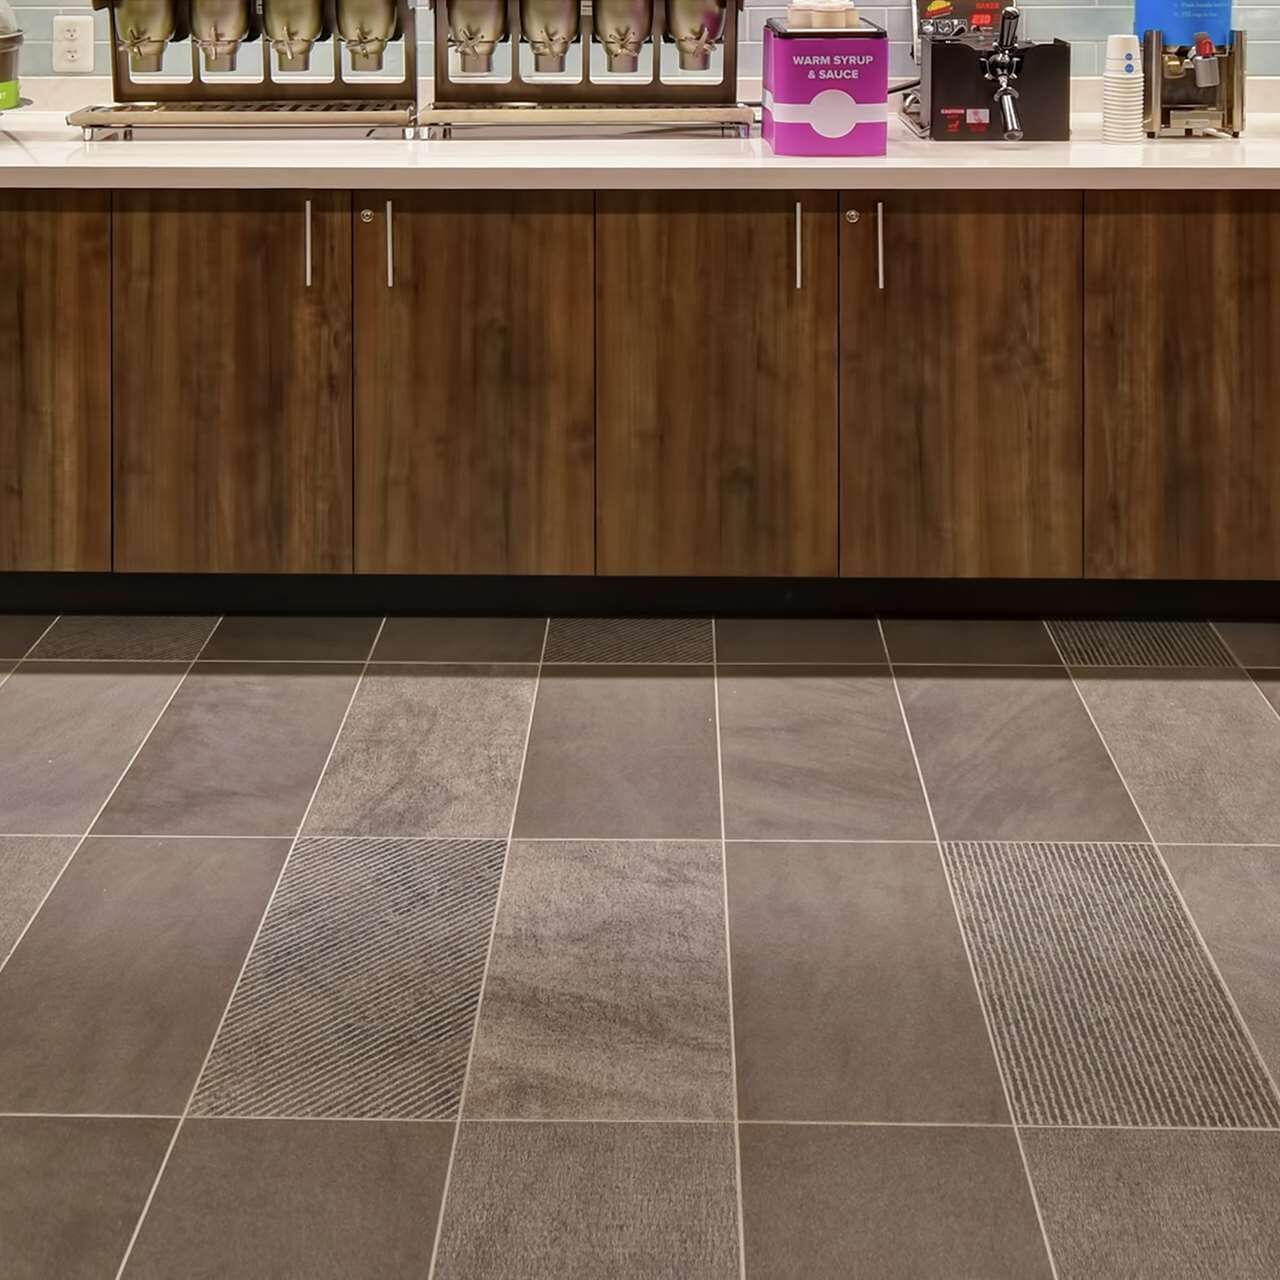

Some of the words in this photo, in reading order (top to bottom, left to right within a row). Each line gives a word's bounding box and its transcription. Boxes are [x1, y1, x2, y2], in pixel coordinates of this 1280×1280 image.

[792, 56, 831, 65] WARM
[833, 55, 874, 65] SYRUP
[807, 70, 816, 79] &
[818, 69, 859, 79] SAUCE
